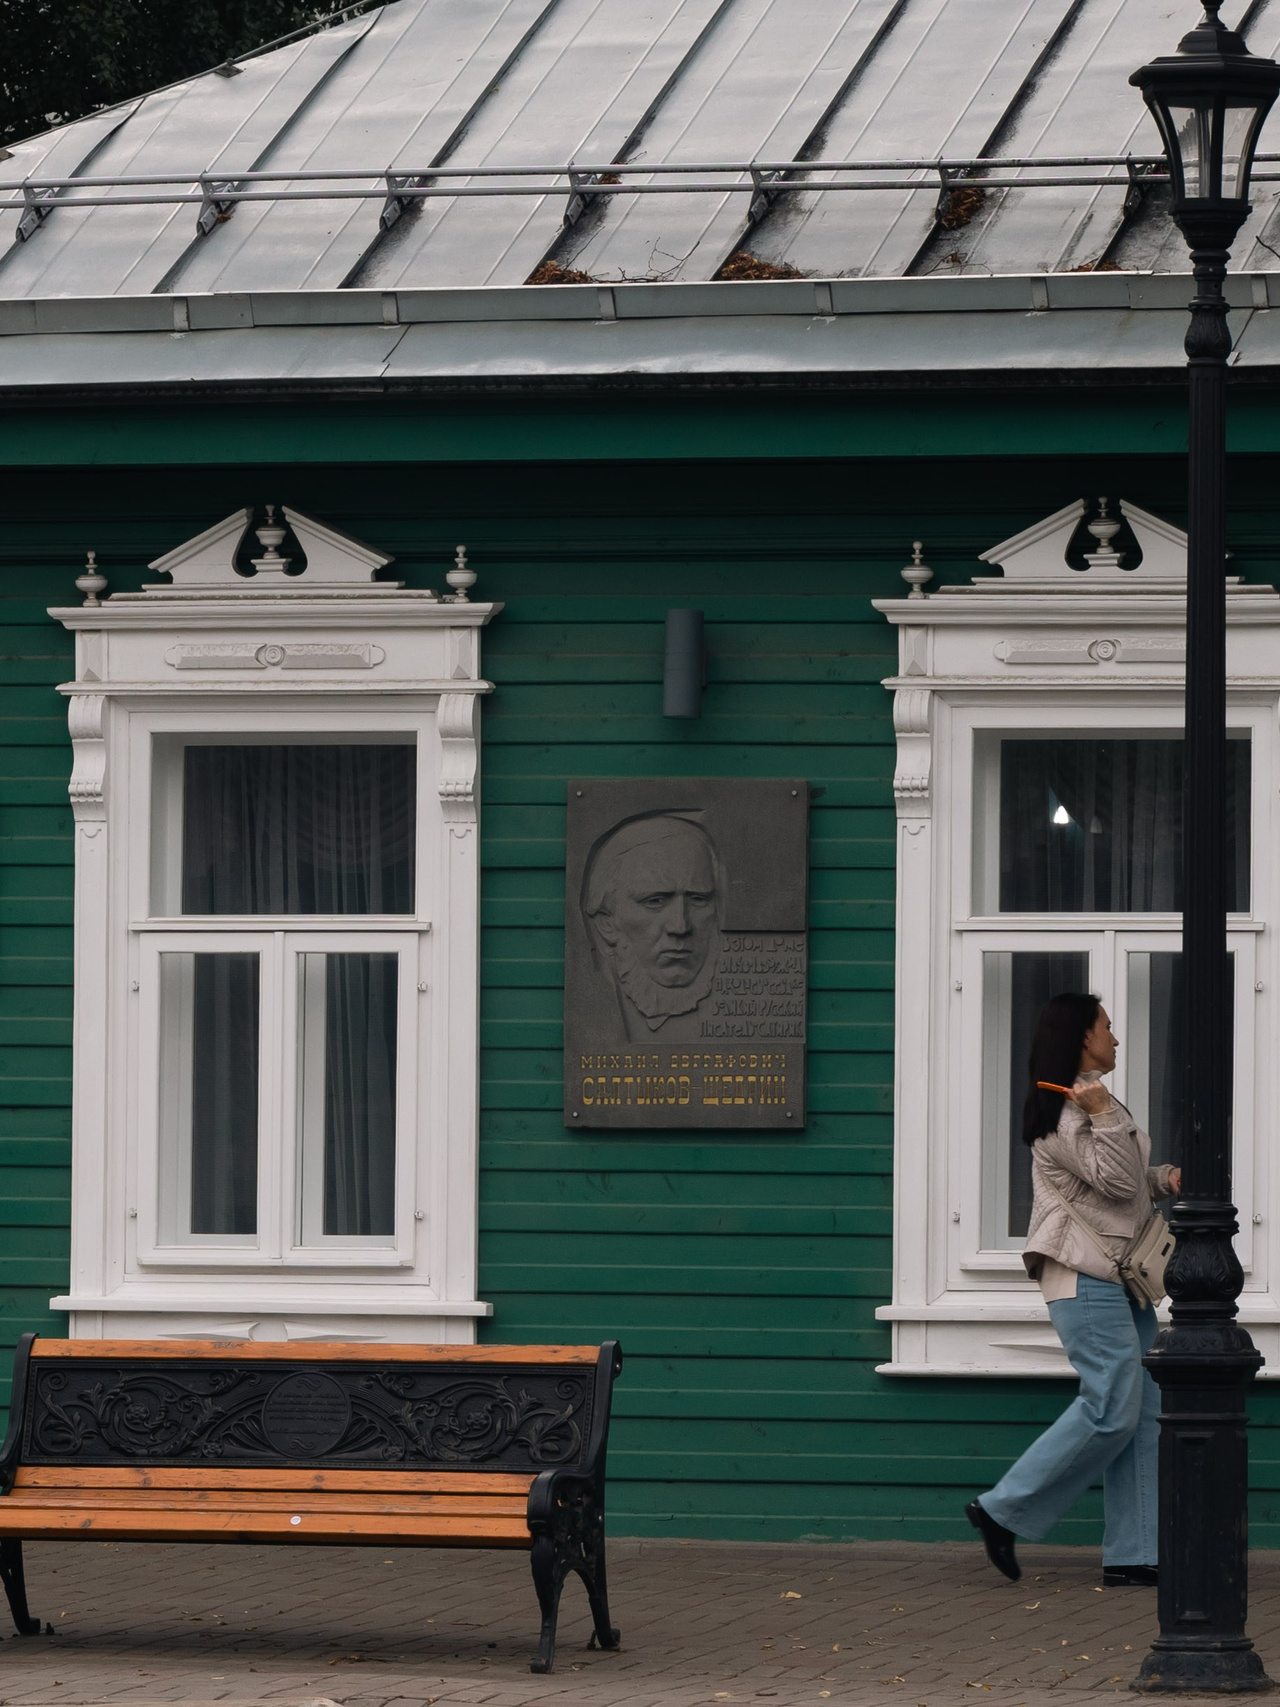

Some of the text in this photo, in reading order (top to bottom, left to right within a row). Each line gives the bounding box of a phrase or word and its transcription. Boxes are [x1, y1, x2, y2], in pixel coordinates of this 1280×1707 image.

[731, 937, 763, 952] ЭТОМ
[581, 1053, 787, 1068] МИХАИЛ ЕВГРАФОВИЧ
[582, 1075, 787, 1106] САЛТЫКОВ-ЩЕДРИН
